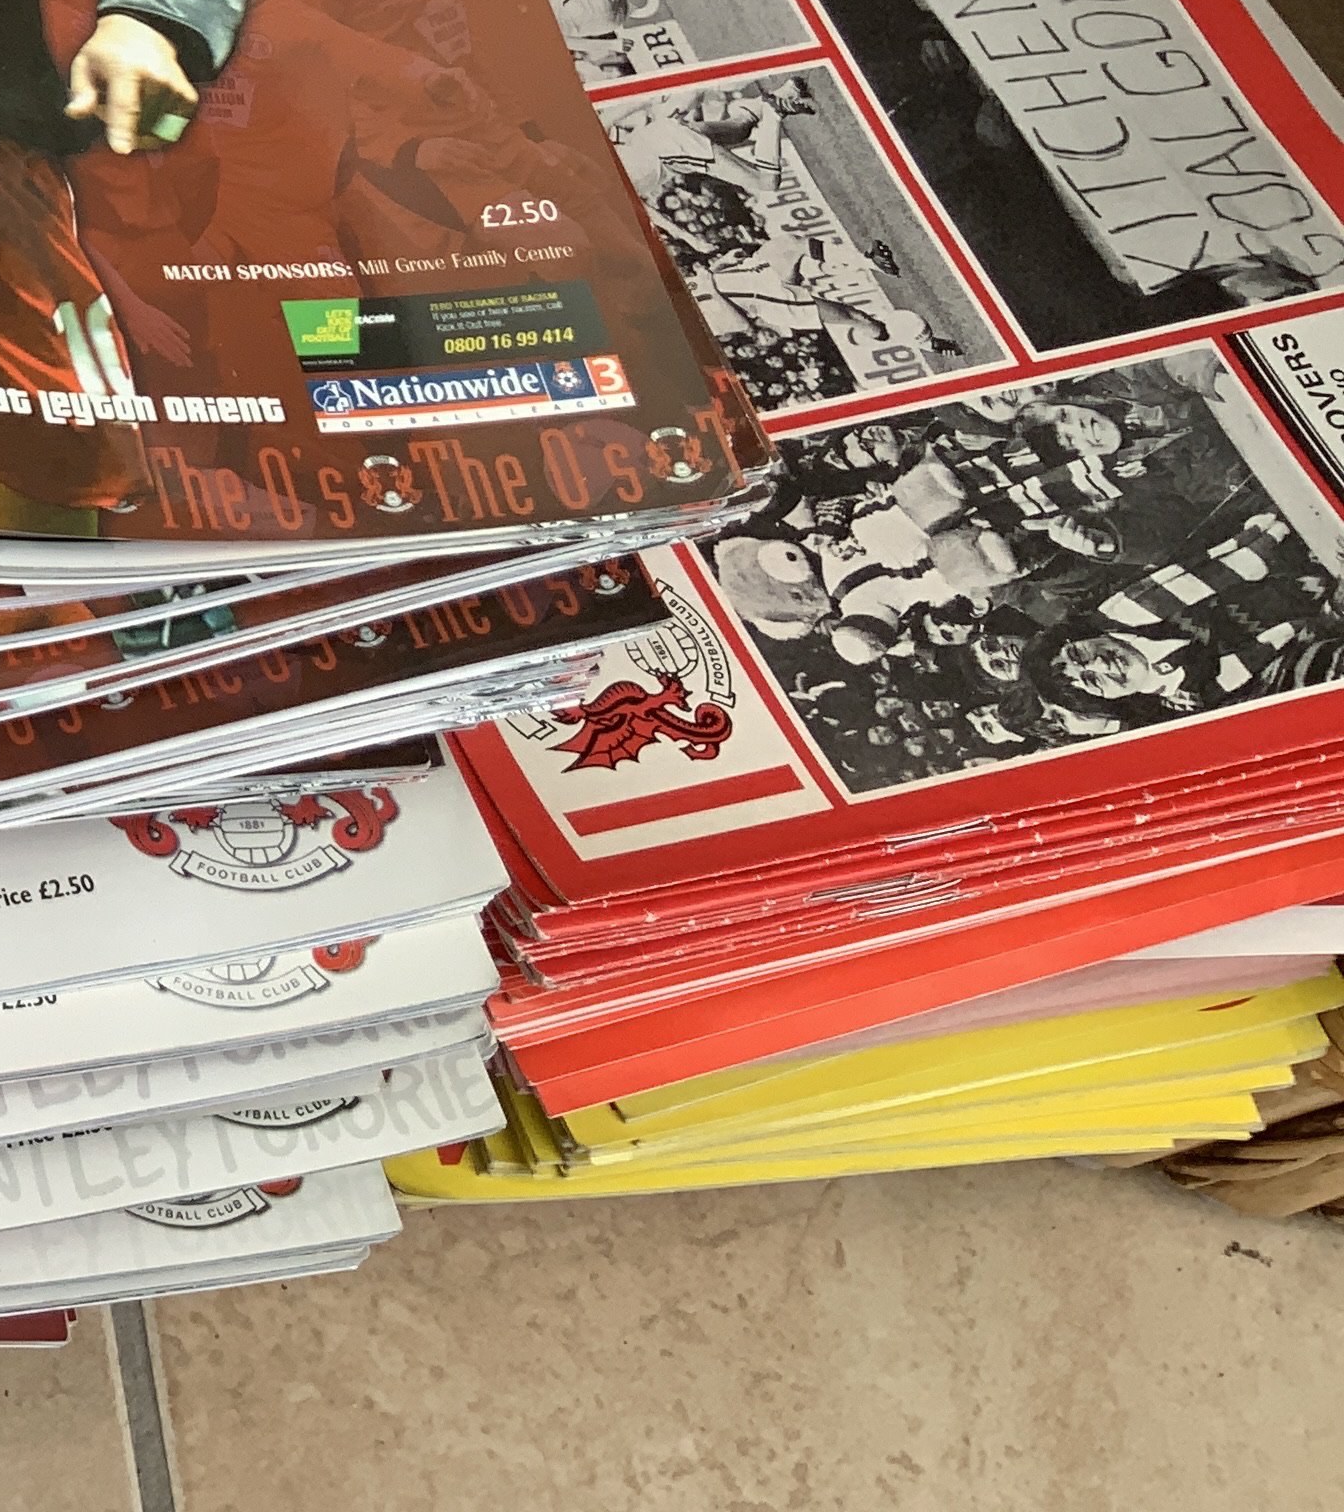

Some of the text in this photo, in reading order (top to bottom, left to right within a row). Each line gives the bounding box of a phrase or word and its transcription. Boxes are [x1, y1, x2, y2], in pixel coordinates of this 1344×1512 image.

[480, 198, 560, 230] £2.50
[161, 241, 575, 283] MATCH SPONSORS: Mill Grove Family Centre
[444, 326, 575, 354] 0800 16 99 414
[351, 367, 542, 412] Nationwide
[597, 357, 626, 394] 3
[238, 819, 266, 830] 1881
[194, 856, 324, 886] FOOTBALL CLUB
[38, 873, 96, 902] £2.50
[172, 975, 302, 1001] FOOTBALL CLUB
[206, 1198, 244, 1219] CLUB
